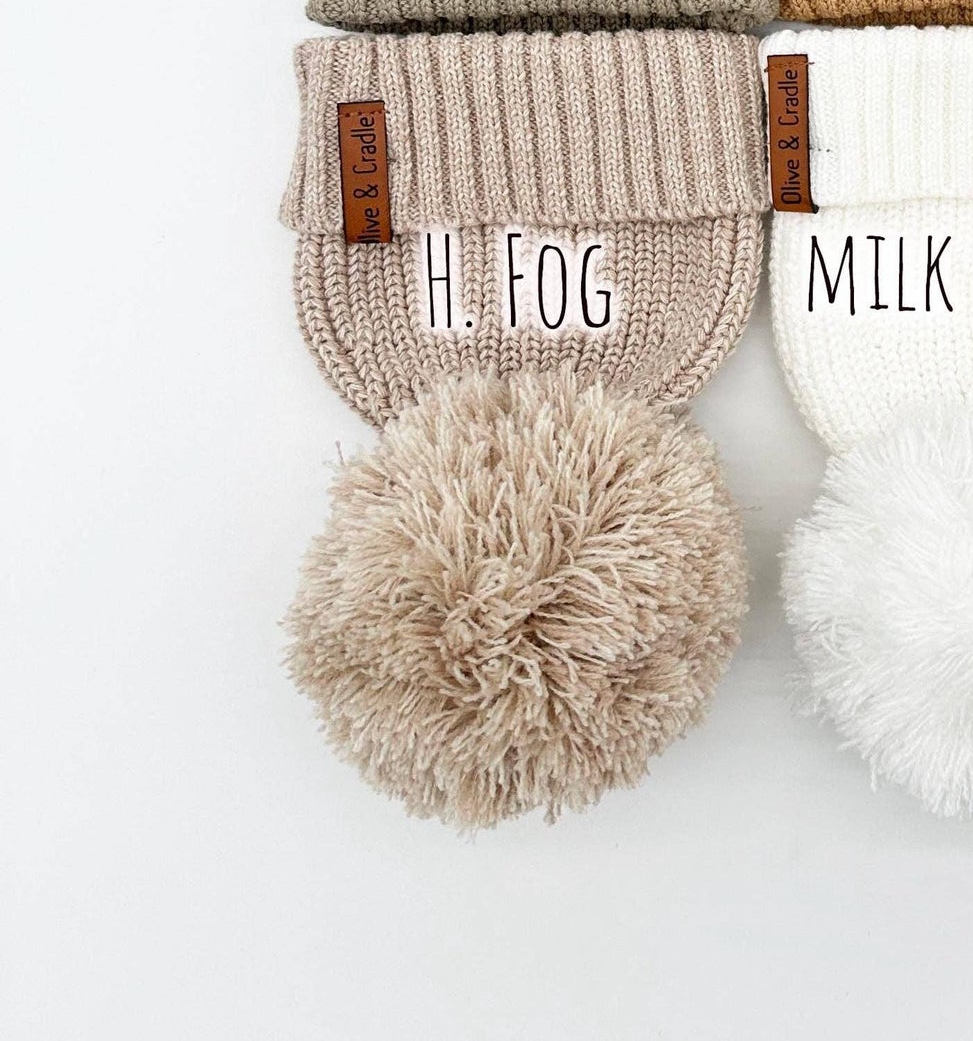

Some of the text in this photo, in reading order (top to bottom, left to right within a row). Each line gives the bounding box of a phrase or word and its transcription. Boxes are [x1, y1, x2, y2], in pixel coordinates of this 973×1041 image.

[350, 116, 381, 243] live & Cradle
[777, 69, 802, 205] Olive & Cradle
